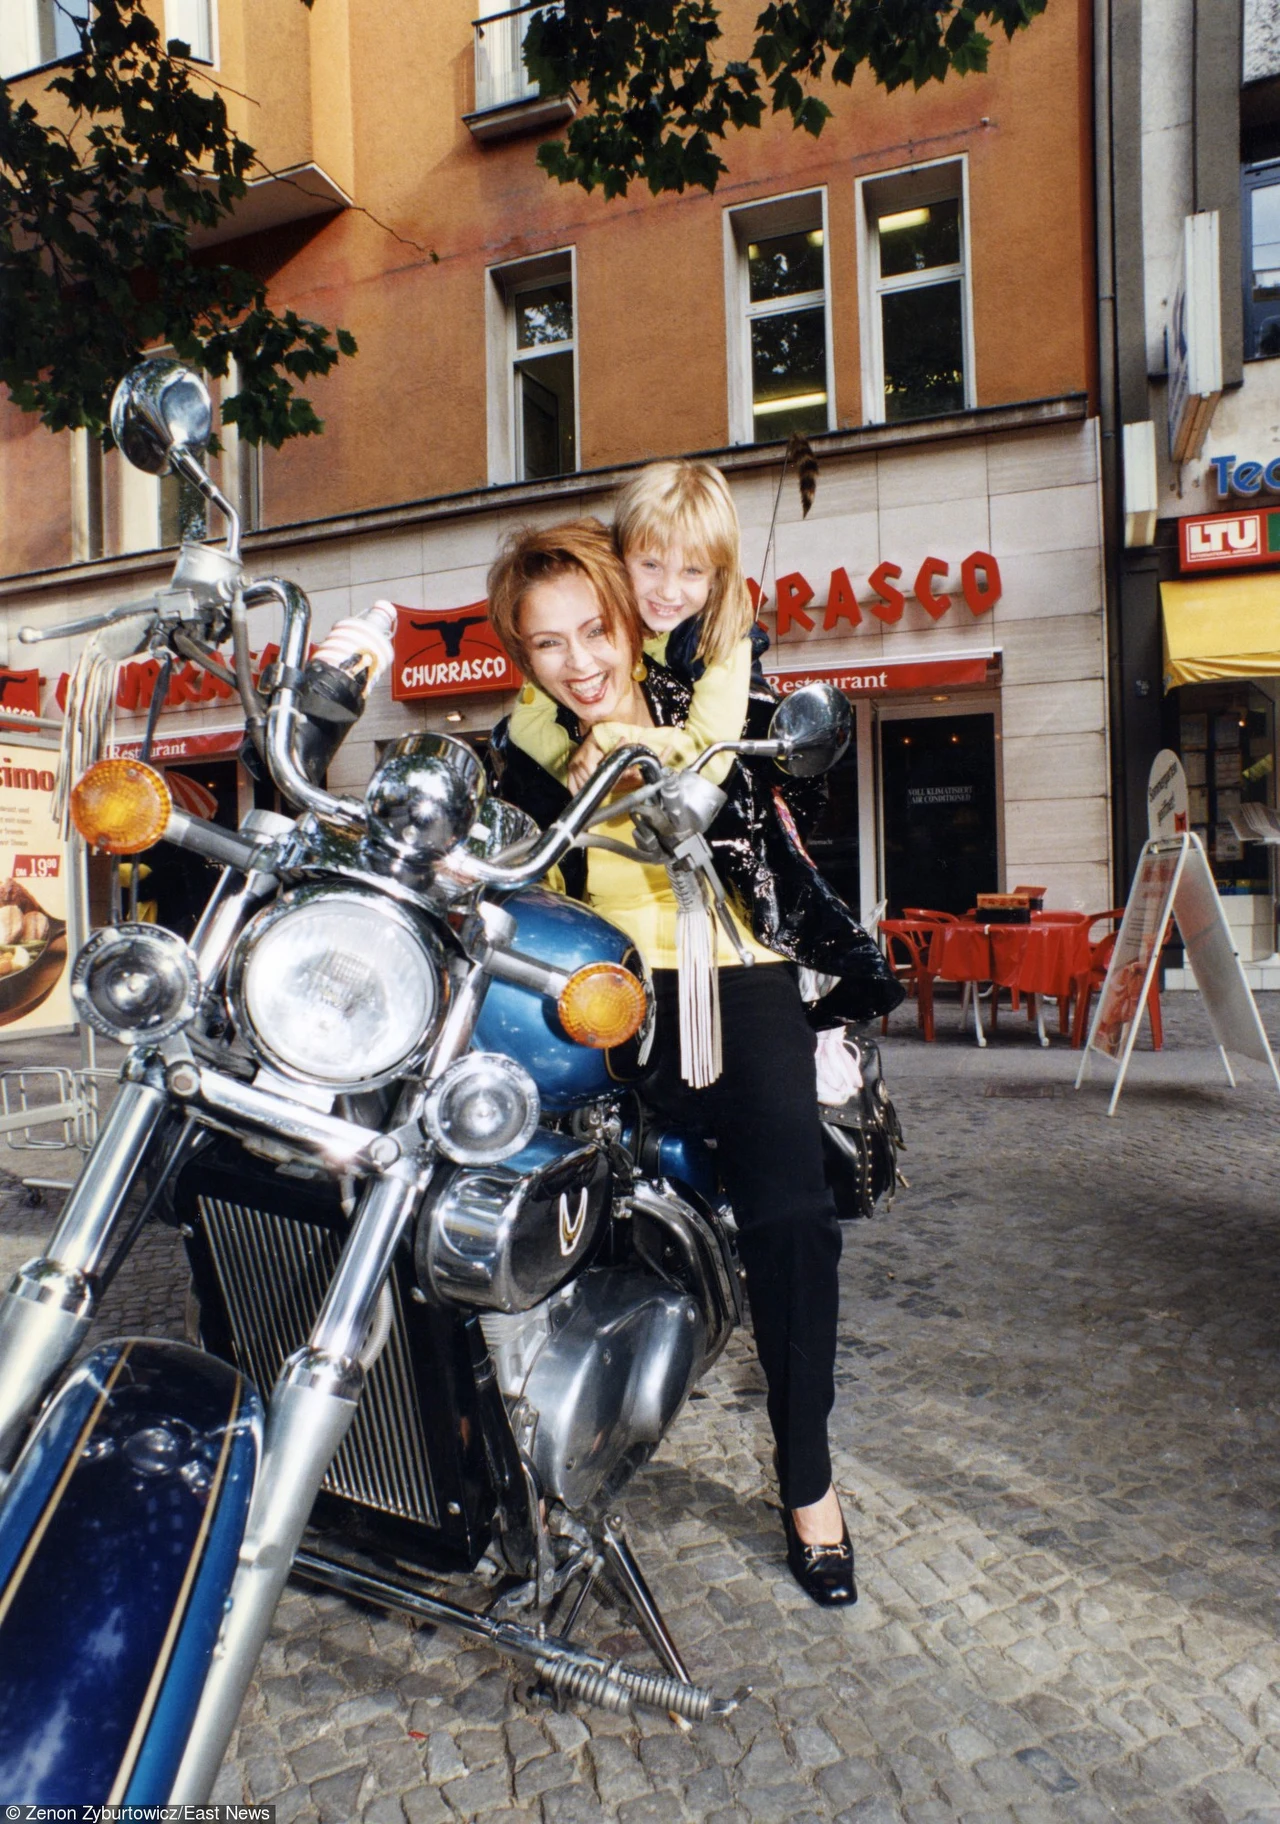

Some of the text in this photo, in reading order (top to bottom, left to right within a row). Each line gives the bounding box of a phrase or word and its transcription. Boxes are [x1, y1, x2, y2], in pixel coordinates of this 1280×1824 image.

[1190, 520, 1255, 553] LTU
[401, 656, 506, 687] CHURRASCO
[111, 742, 187, 760] Resturant
[0, 757, 55, 792] imo
